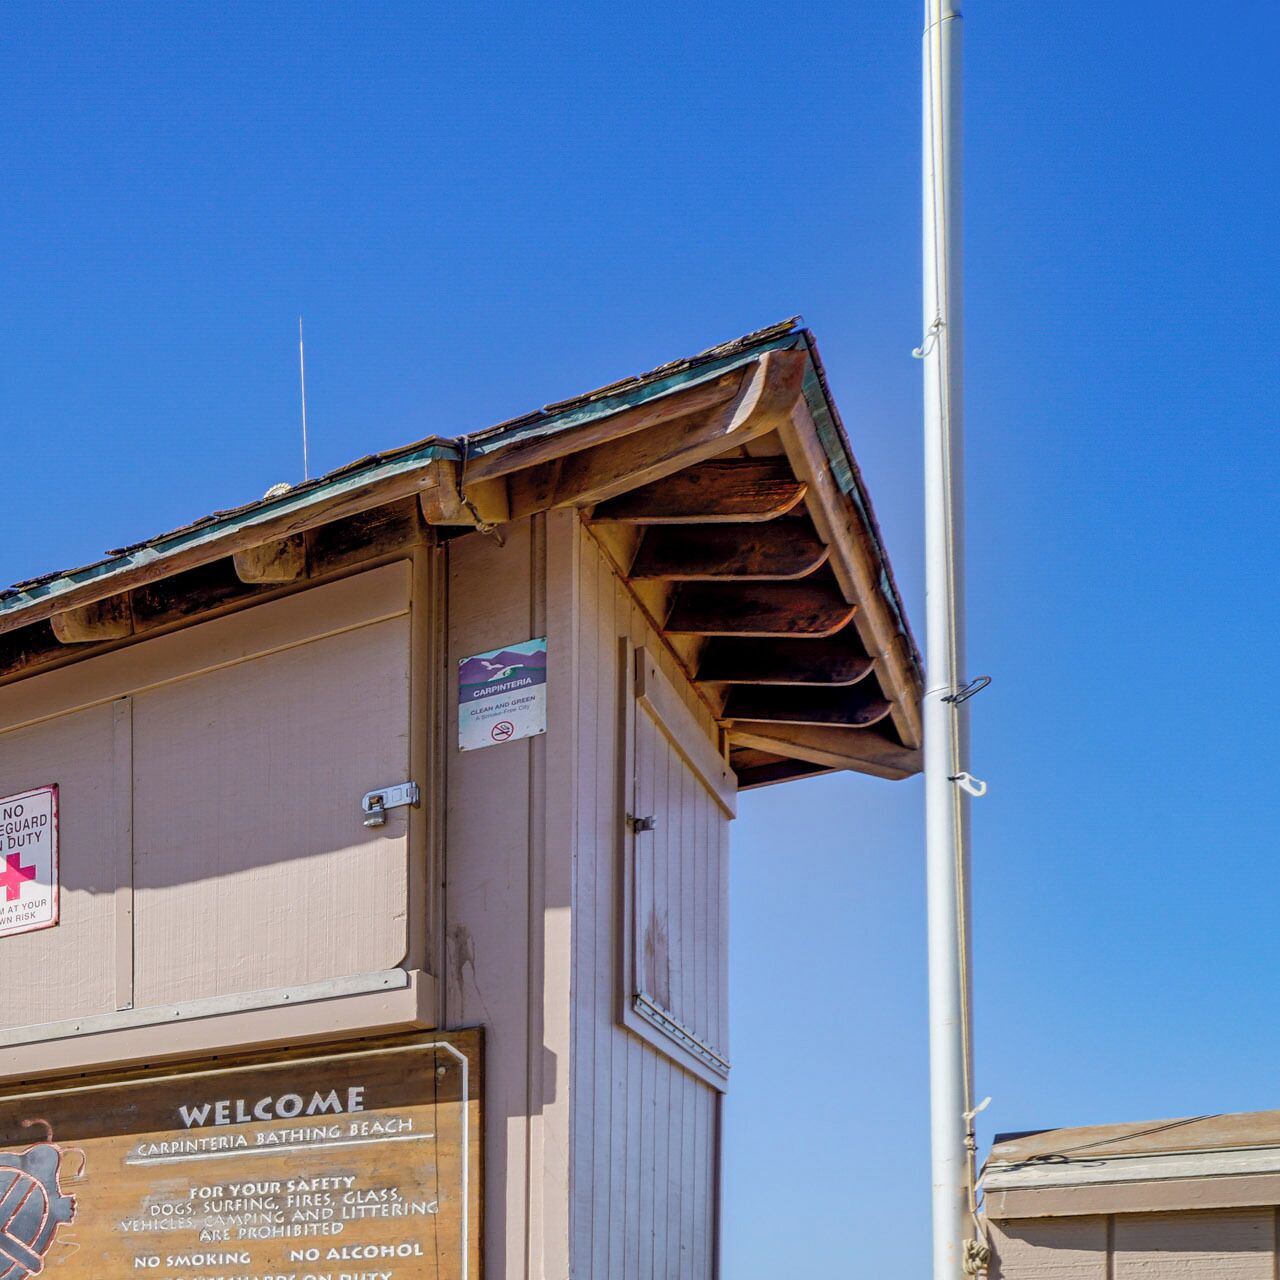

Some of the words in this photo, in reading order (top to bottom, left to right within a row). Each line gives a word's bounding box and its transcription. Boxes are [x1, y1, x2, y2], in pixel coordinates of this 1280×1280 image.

[473, 677, 532, 697] CARPINTERIA
[471, 706, 493, 716] CLEAN
[495, 702, 510, 710] AND
[511, 696, 536, 706] GREEN
[3, 804, 24, 821] NO
[7, 831, 42, 849] DUTY
[8, 904, 19, 914] AT
[22, 898, 48, 910] YOUR
[15, 911, 37, 922] RISK
[178, 1086, 365, 1128] WELCOME
[138, 1135, 248, 1156] CARPINTERIA
[255, 1124, 340, 1145] BATHING
[349, 1118, 413, 1137] BEACH
[190, 1186, 223, 1200] FOR
[229, 1182, 281, 1197] YOUR
[287, 1176, 355, 1192] SAFETY
[150, 1202, 196, 1216] DOGS,
[203, 1197, 280, 1213] SURFING,
[287, 1193, 336, 1207] FIRES,
[343, 1188, 403, 1204] GLASS,
[204, 1211, 285, 1227] CAMPING
[292, 1208, 333, 1222] AND
[342, 1201, 438, 1219] LITTERING
[199, 1228, 230, 1242] ARE
[239, 1222, 344, 1239] PROHIBITED
[134, 1256, 161, 1268] NO
[167, 1252, 251, 1267] SMOKING
[290, 1248, 320, 1262] NO
[326, 1244, 423, 1260] ALCOHOL
